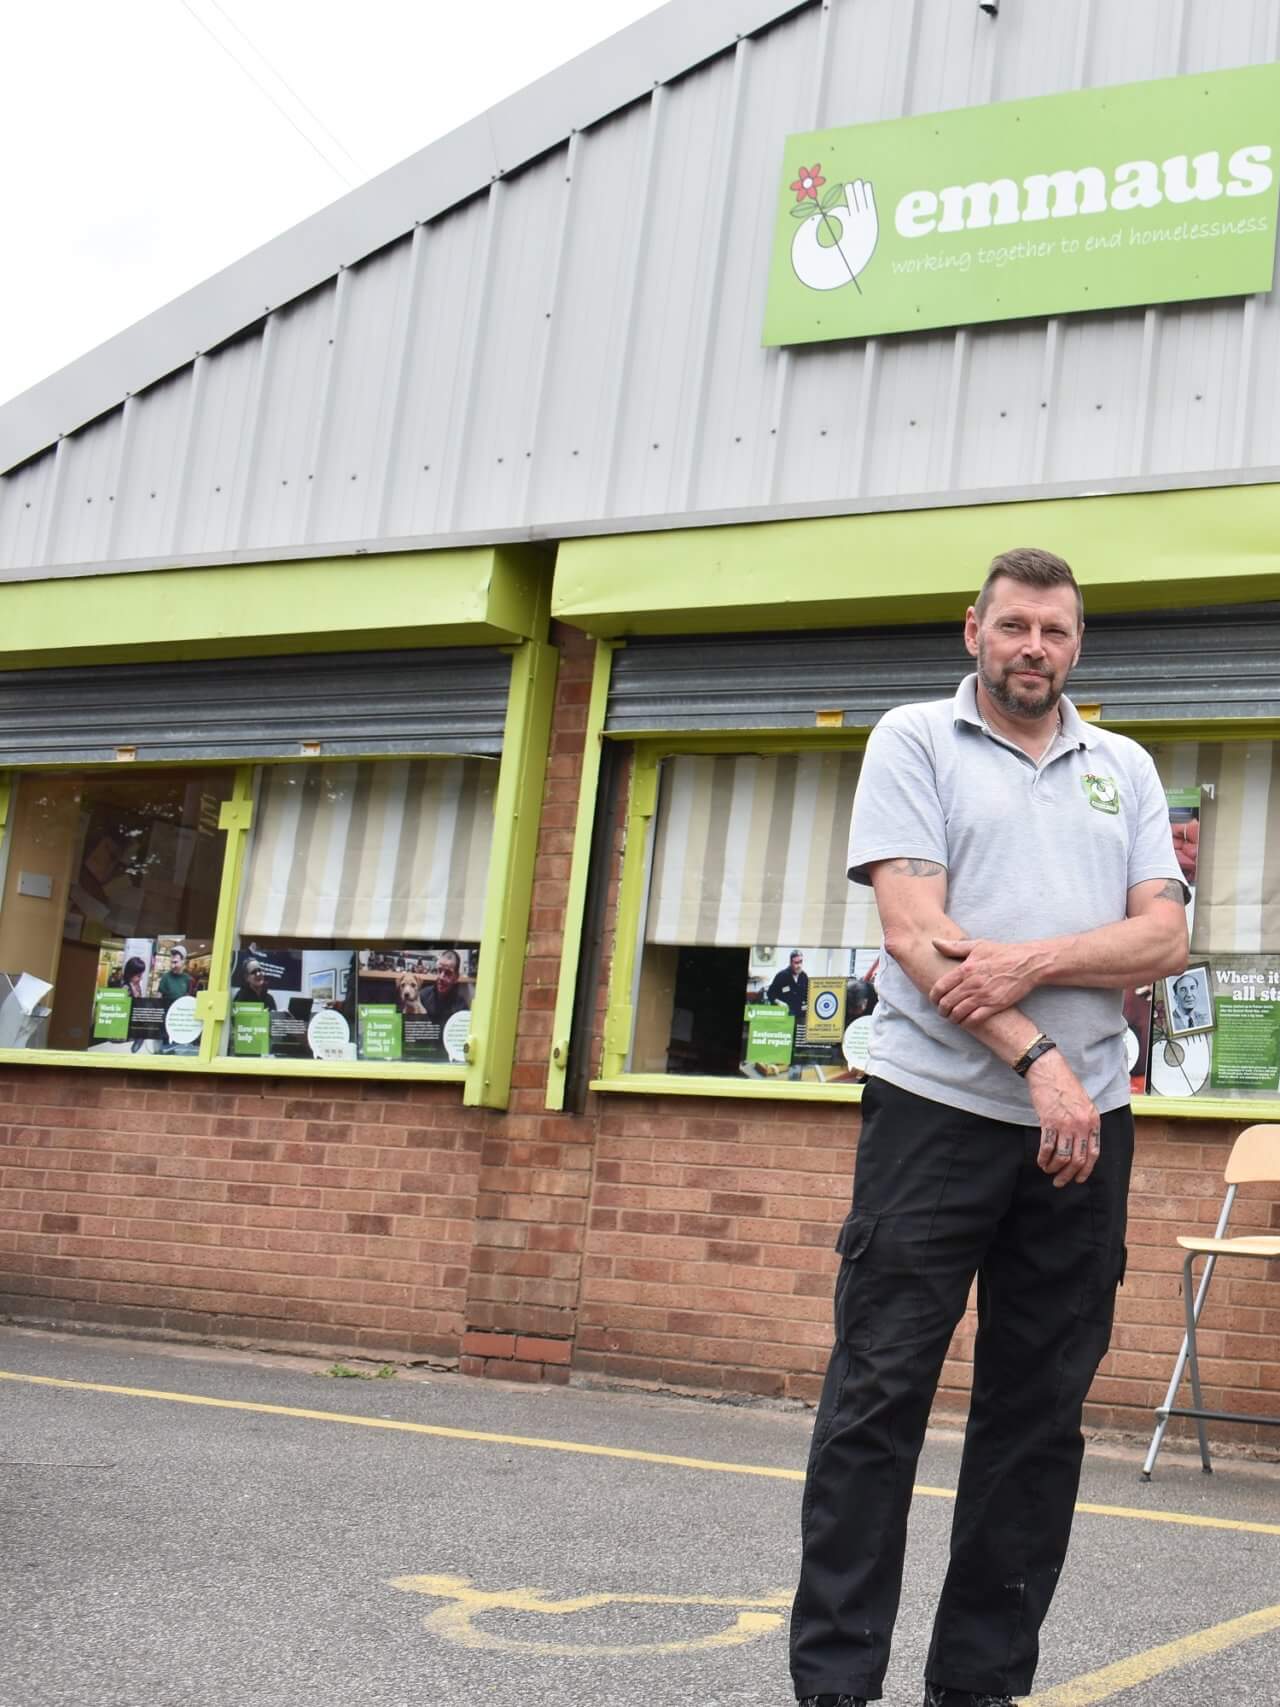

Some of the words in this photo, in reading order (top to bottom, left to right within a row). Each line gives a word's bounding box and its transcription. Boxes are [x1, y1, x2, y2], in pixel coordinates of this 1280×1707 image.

[895, 145, 1272, 238] emmaus
[892, 251, 971, 273] working
[977, 240, 1056, 267] together
[1062, 237, 1079, 253] to
[1085, 229, 1123, 251] end
[1129, 216, 1268, 246] homelessness
[1216, 970, 1265, 984] Where
[1268, 971, 1280, 984] it
[1232, 986, 1256, 1001] all
[752, 1030, 792, 1039] Restoration
[752, 1037, 766, 1045] and
[767, 1038, 792, 1047] repair
